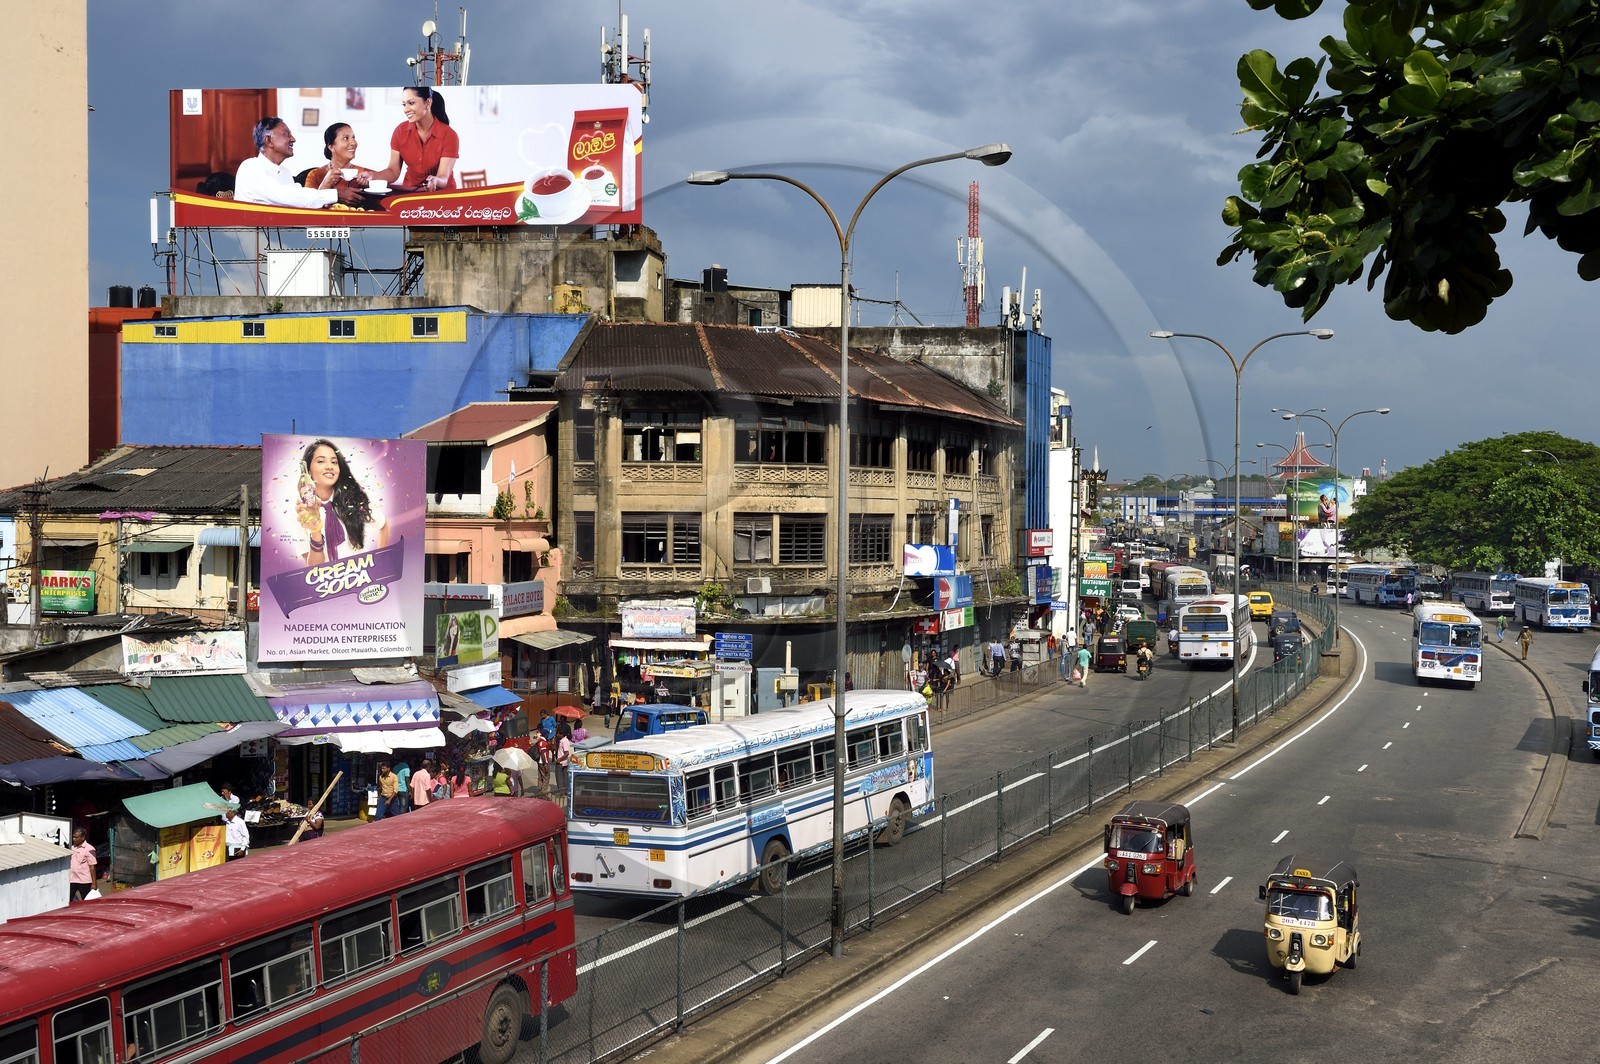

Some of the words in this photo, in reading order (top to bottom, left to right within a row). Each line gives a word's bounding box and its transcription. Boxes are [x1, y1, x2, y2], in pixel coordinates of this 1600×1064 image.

[400, 205, 463, 219] සත්කාරයේ
[464, 206, 512, 221] රසමුසුව
[305, 553, 375, 585] CREAM
[315, 569, 373, 599] SODA
[41, 589, 87, 597] ENTERPRISES
[503, 593, 525, 606] PALACE
[526, 590, 544, 602] HOTEL
[1086, 588, 1107, 597] BAR
[284, 622, 329, 632] NADEEMA
[330, 621, 406, 632] COMMUNICATION
[293, 636, 340, 645] MADDUMA
[341, 634, 397, 644] ENTERPRISESS
[307, 647, 331, 655] Market,
[331, 646, 350, 654] Olcott
[350, 645, 379, 653] Mawatha,
